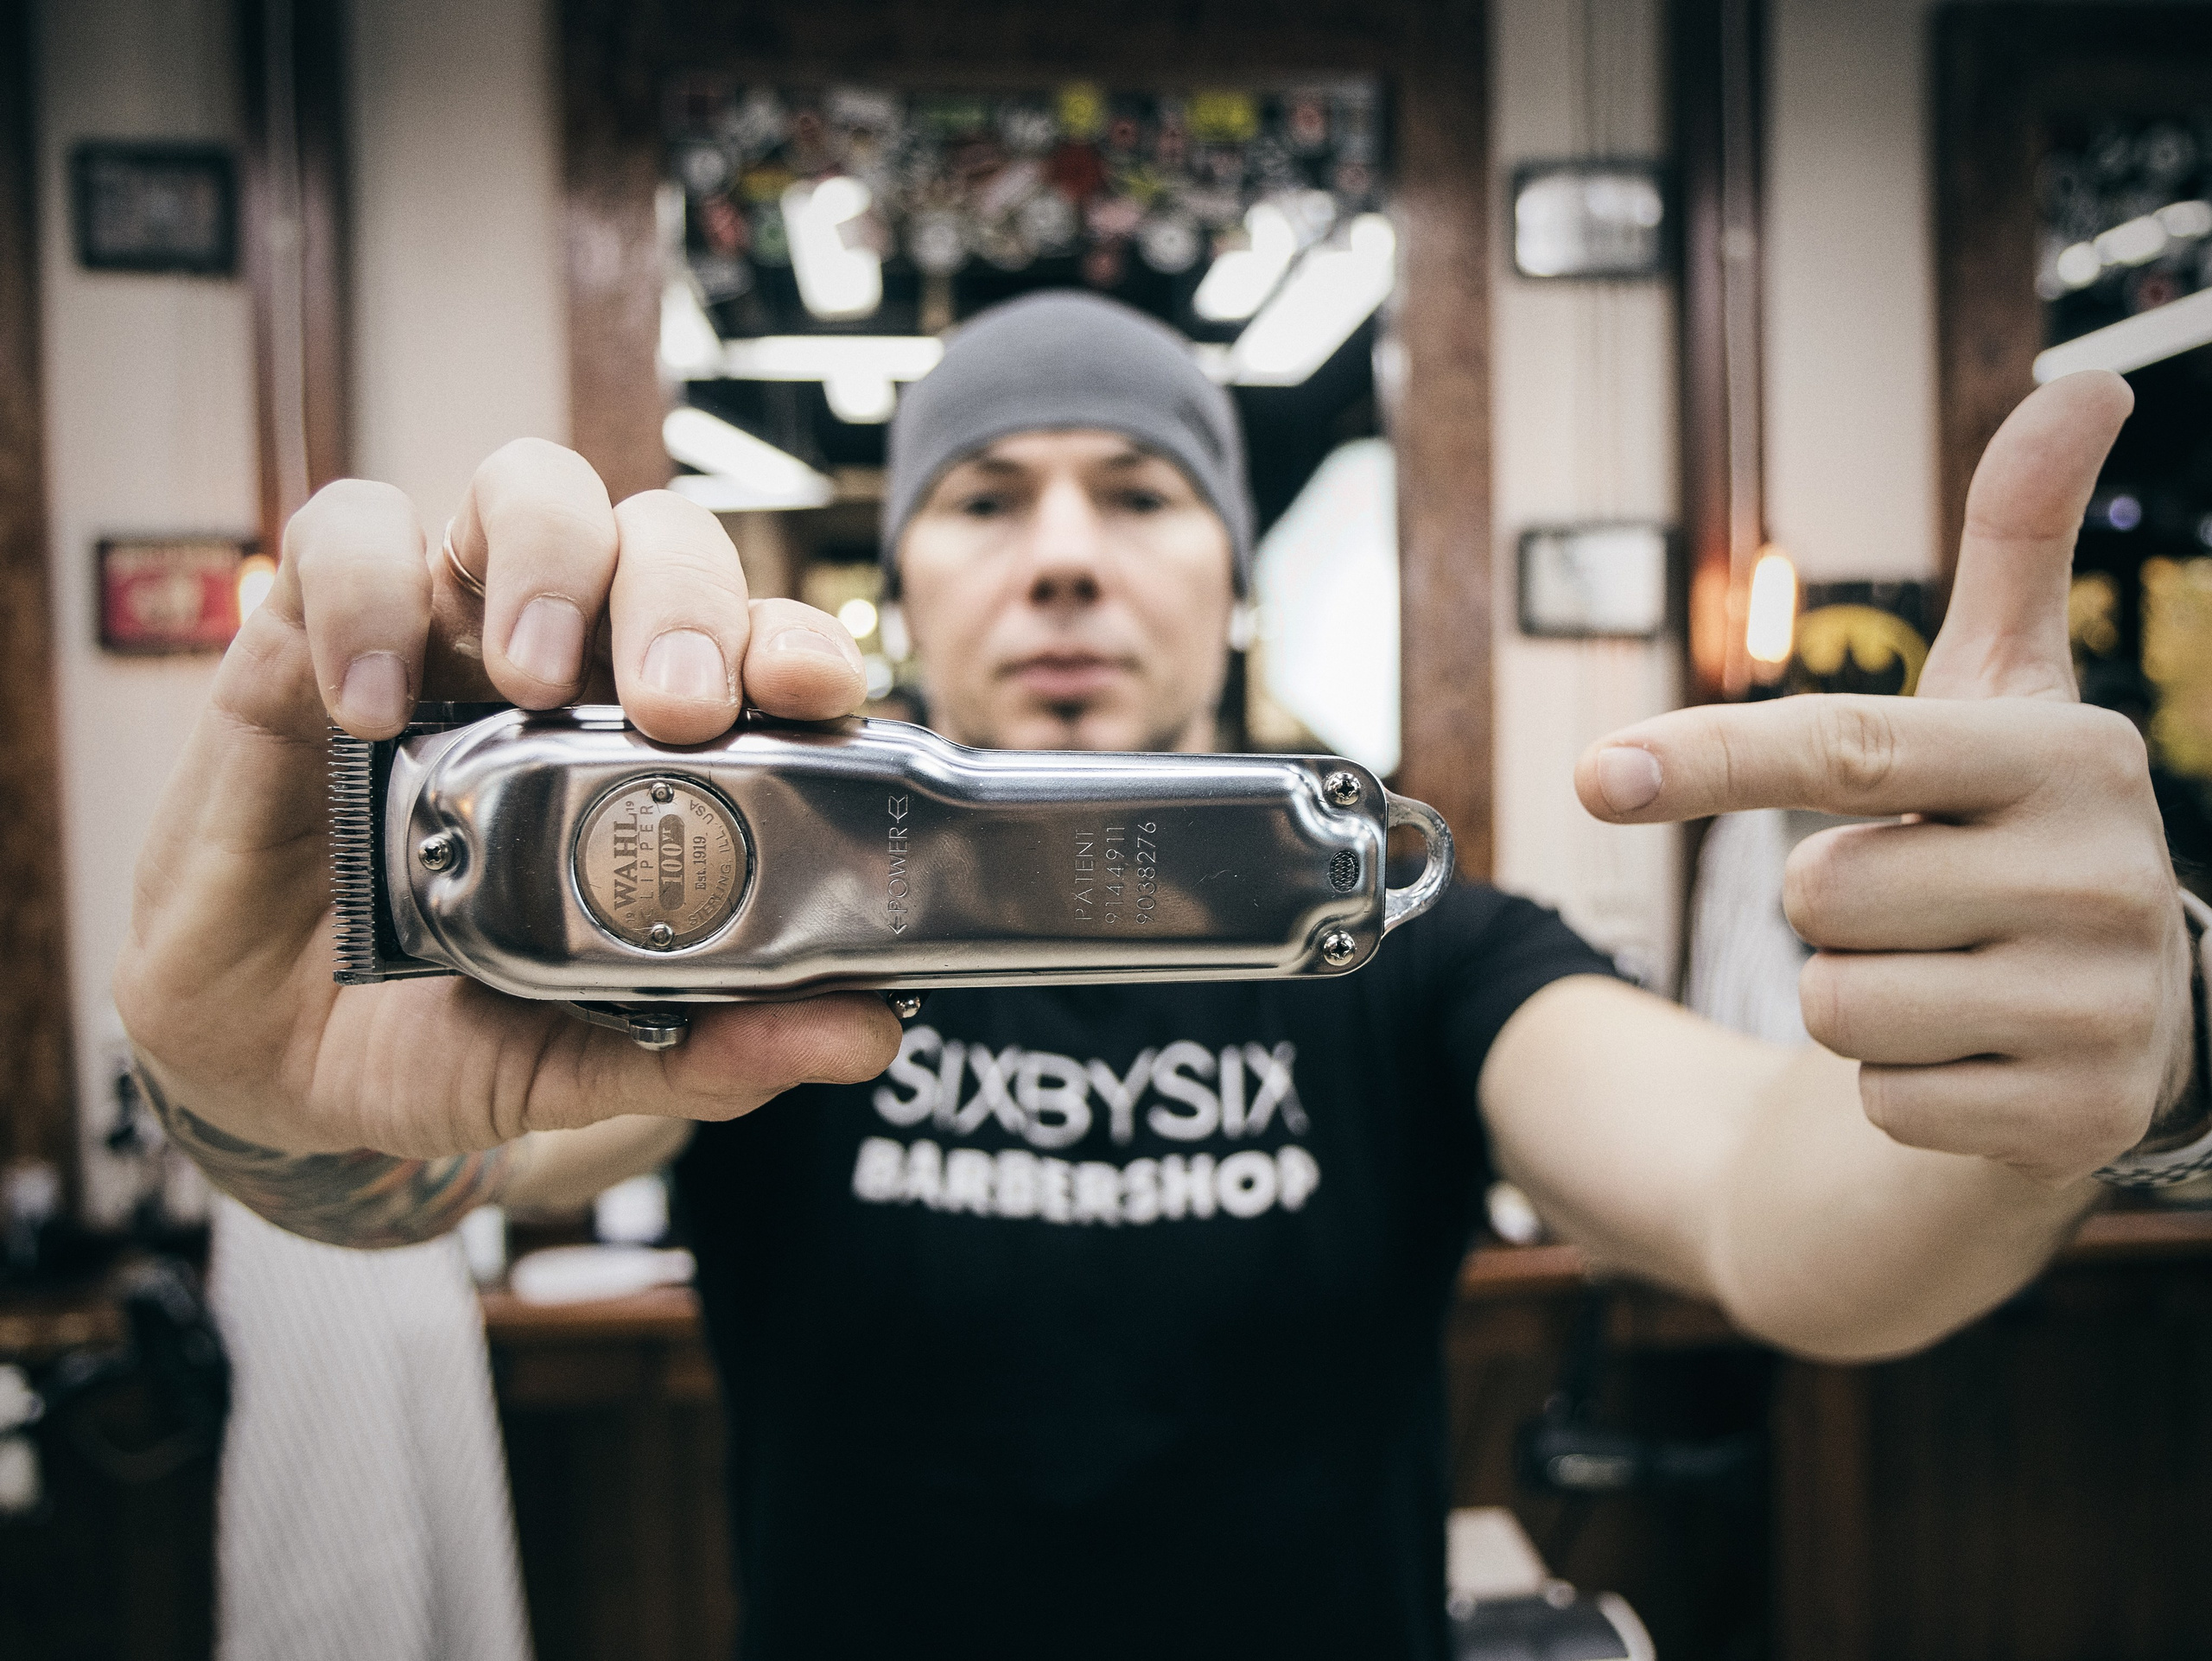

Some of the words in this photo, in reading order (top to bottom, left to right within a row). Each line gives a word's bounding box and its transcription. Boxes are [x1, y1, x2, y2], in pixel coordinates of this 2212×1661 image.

[613, 813, 638, 910] WAHL
[626, 800, 635, 811] 19
[689, 799, 714, 824] USA
[693, 836, 707, 864] 1919
[639, 805, 654, 920] CLIPPER
[695, 868, 707, 890] Est.
[887, 827, 908, 913] POWER
[1074, 829, 1094, 920] PATENT
[1104, 826, 1125, 925] 9144911
[1135, 822, 1157, 925] 9038276
[872, 1025, 1311, 1149] SIXBYSIX
[850, 1136, 1320, 1227] BARBERSHOP
